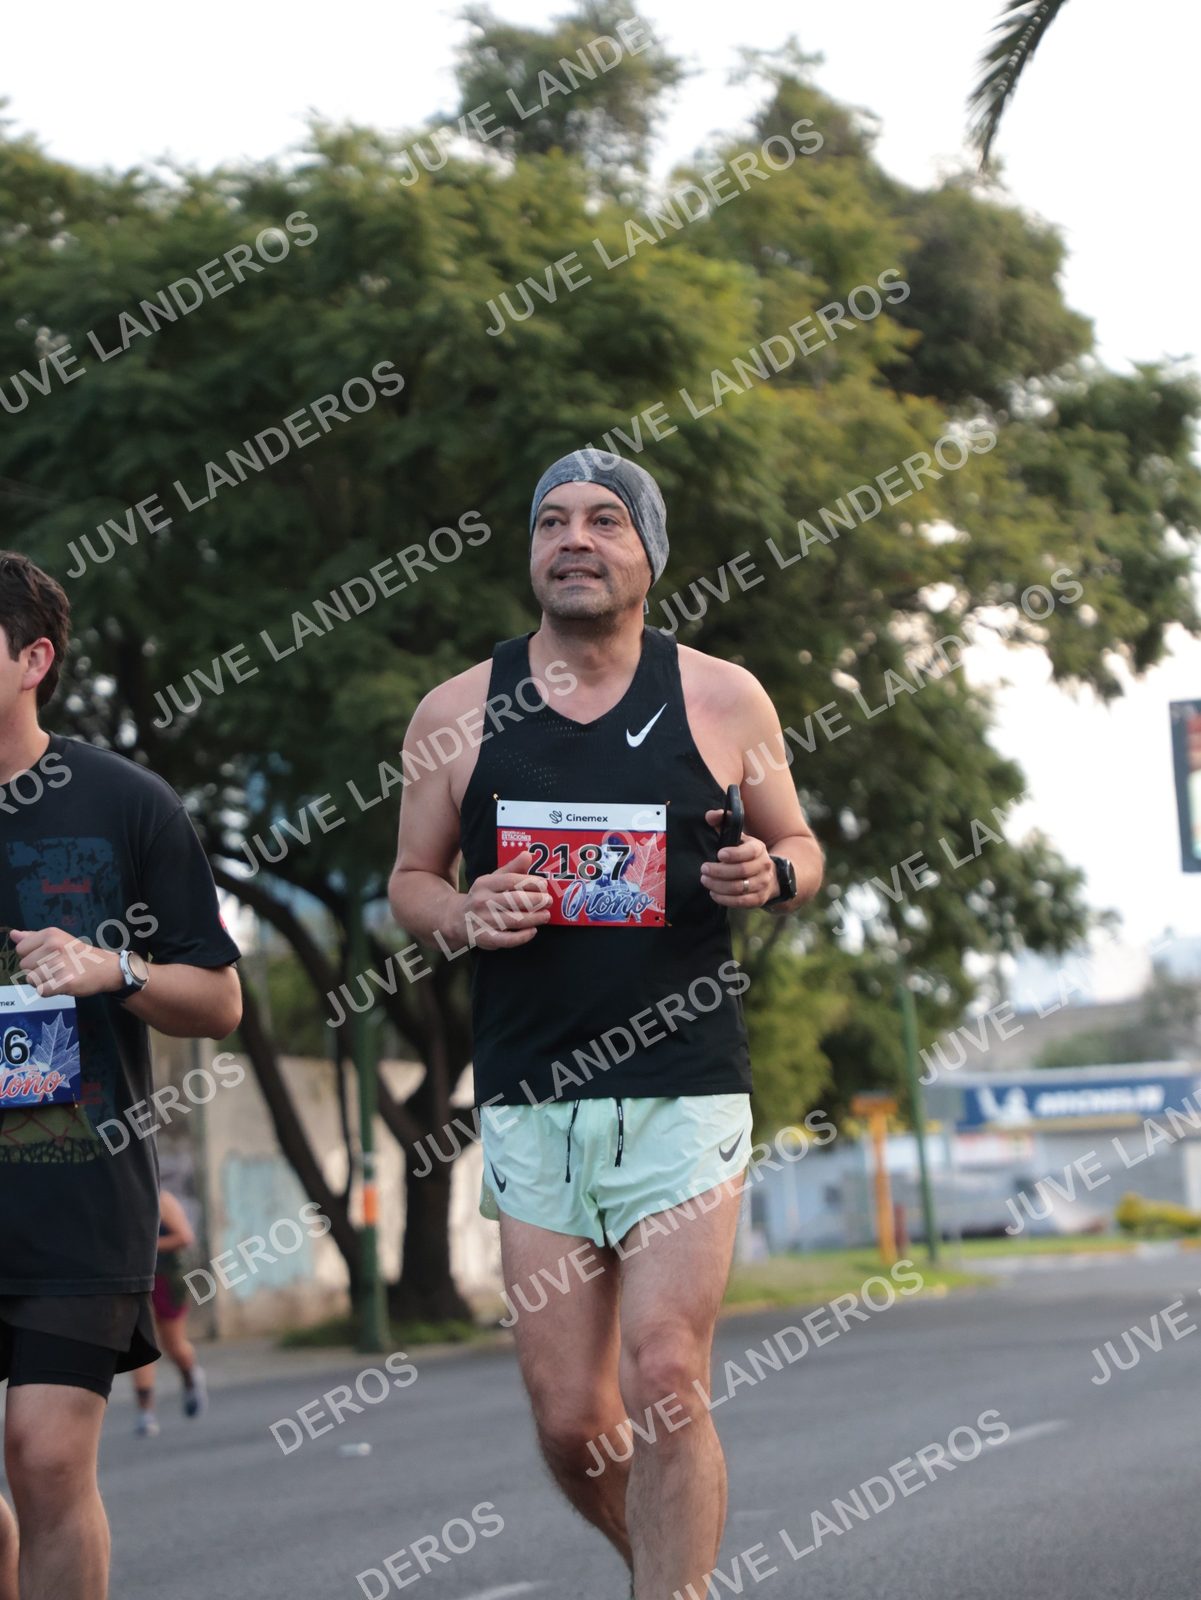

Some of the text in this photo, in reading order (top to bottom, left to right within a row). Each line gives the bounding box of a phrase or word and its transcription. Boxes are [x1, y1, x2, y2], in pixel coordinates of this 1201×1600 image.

[566, 813, 608, 823] Cinemex
[527, 842, 631, 881] 2187
[561, 880, 654, 919] Otoño
[0, 1028, 30, 1066] 6
[0, 1066, 65, 1099] toño
